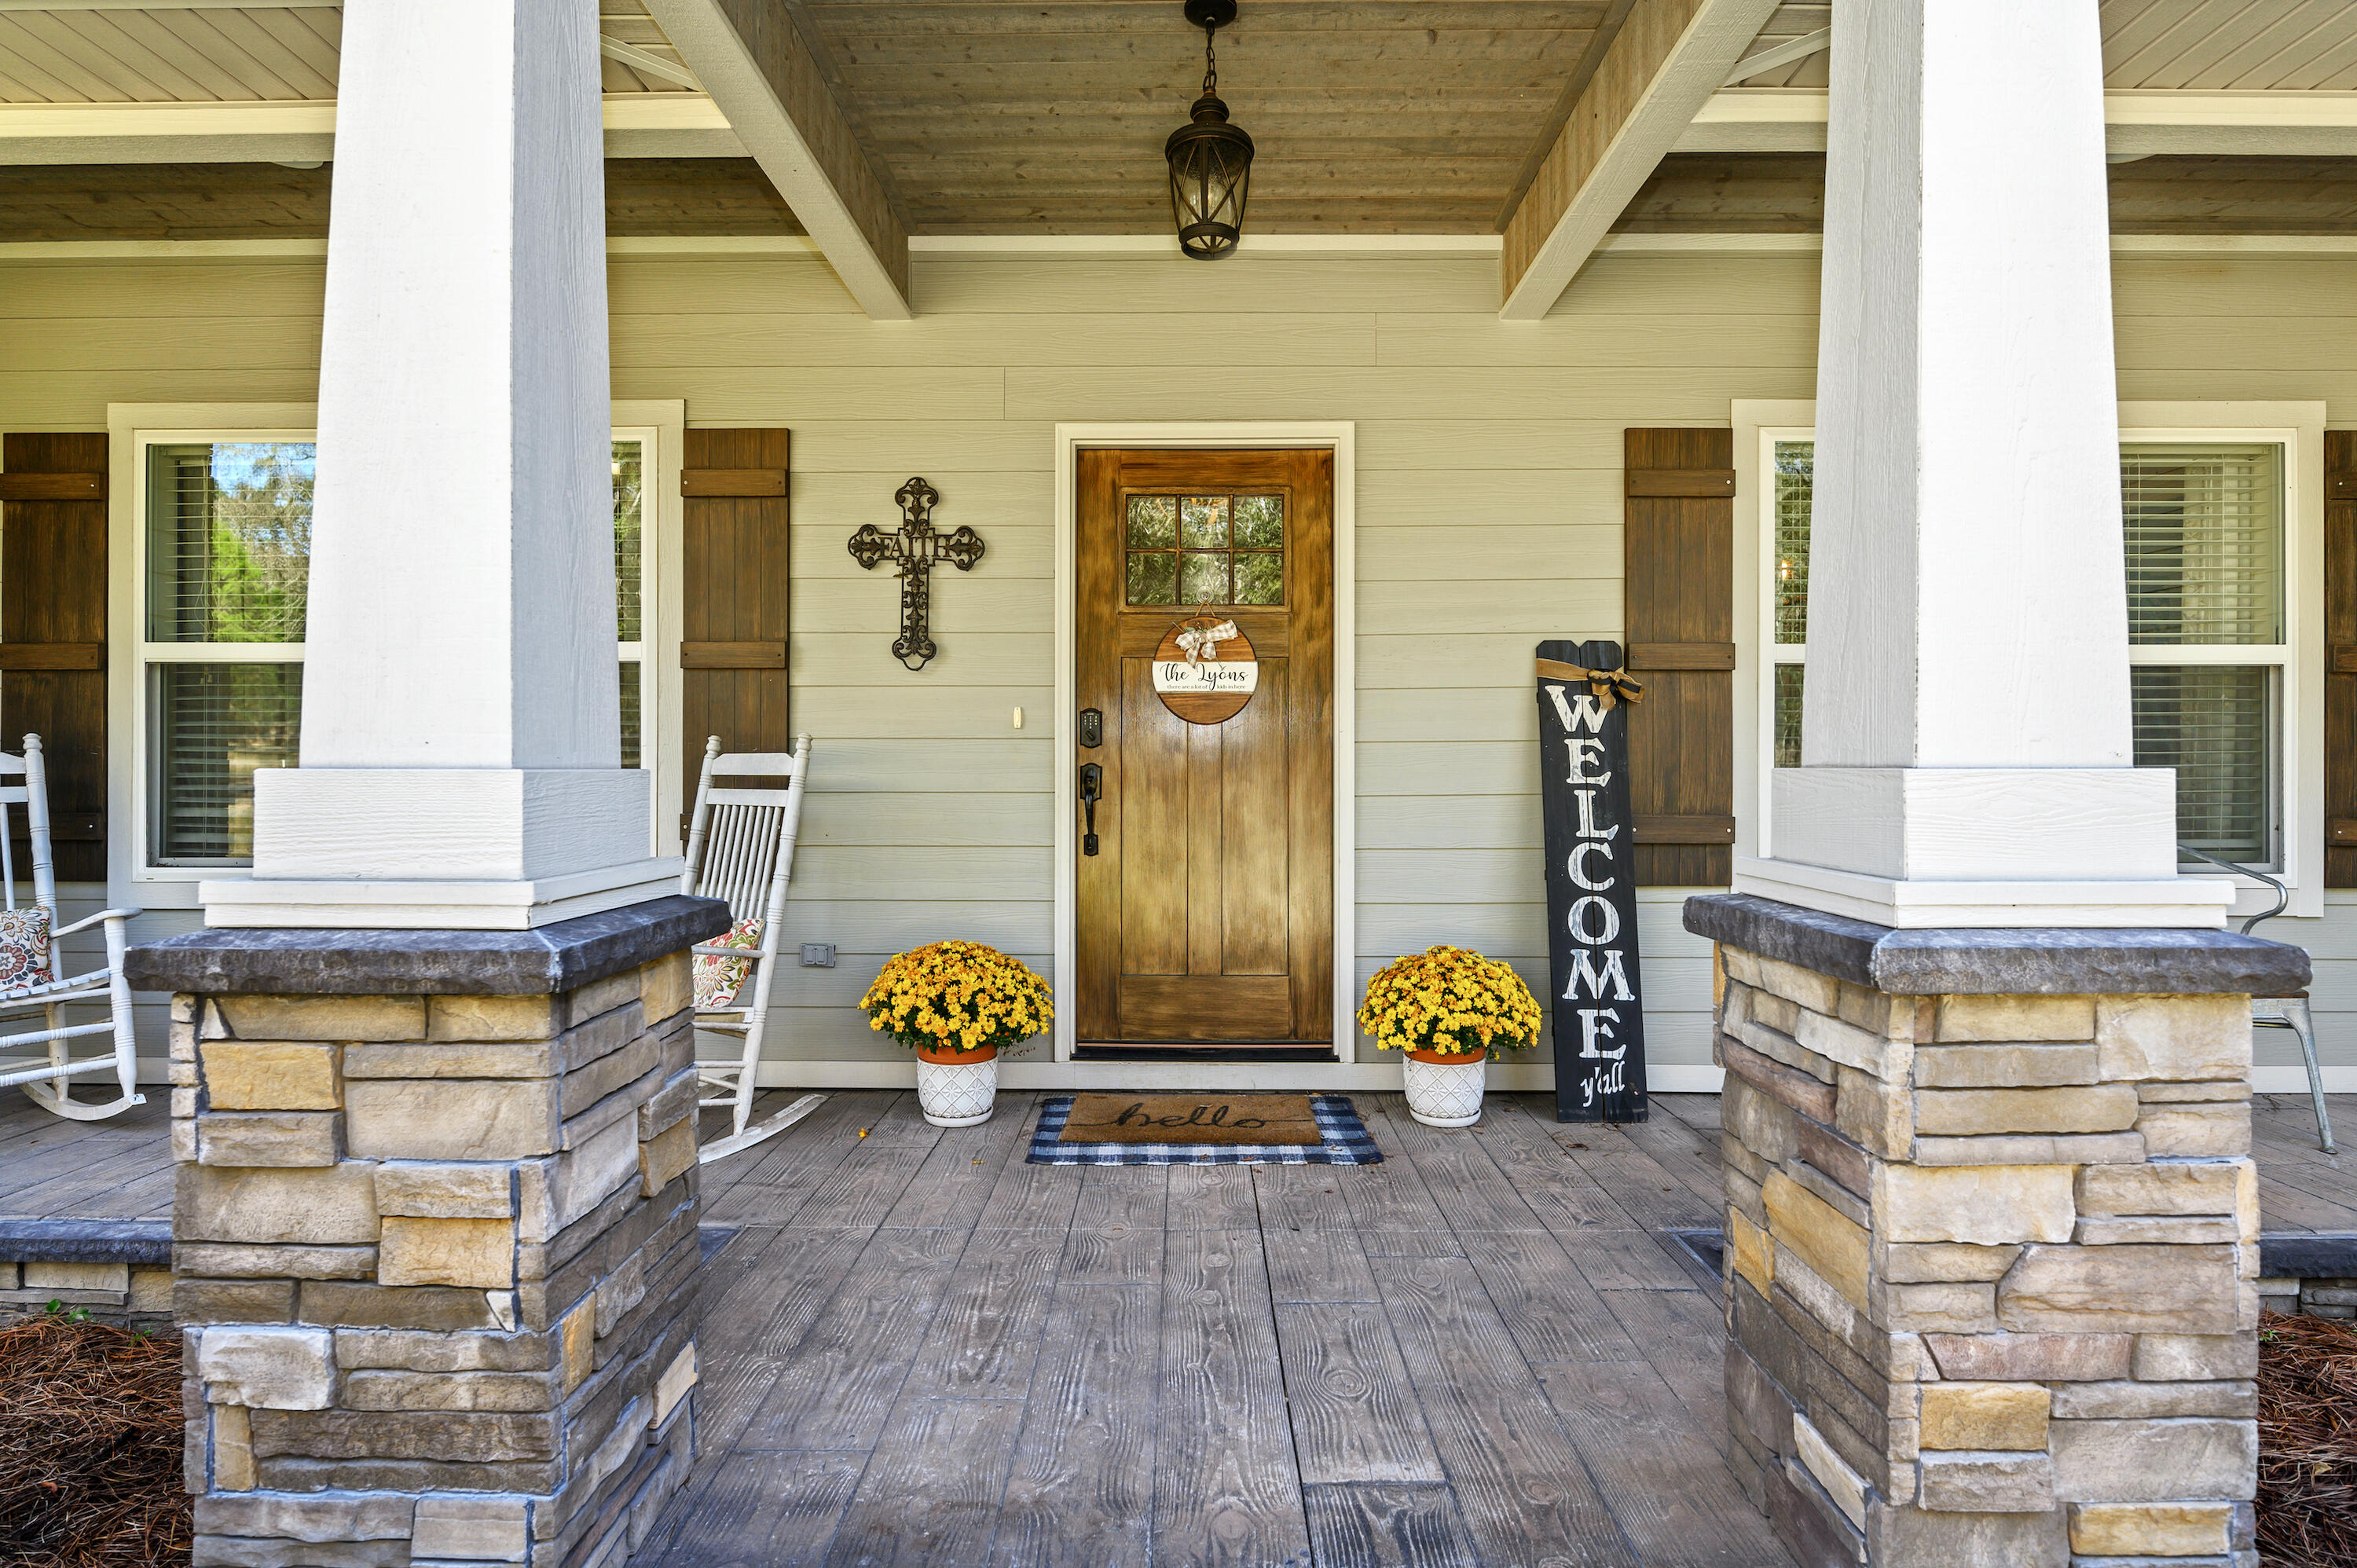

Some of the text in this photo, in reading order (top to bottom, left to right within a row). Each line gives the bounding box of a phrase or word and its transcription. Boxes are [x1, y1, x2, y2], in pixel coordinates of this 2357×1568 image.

[878, 535, 953, 558] FAITH
[1197, 662, 1248, 691] Lyons
[1544, 685, 1636, 1061] WELCOME
[1580, 1060, 1626, 1107] y'all
[1069, 1102, 1314, 1129] hello
